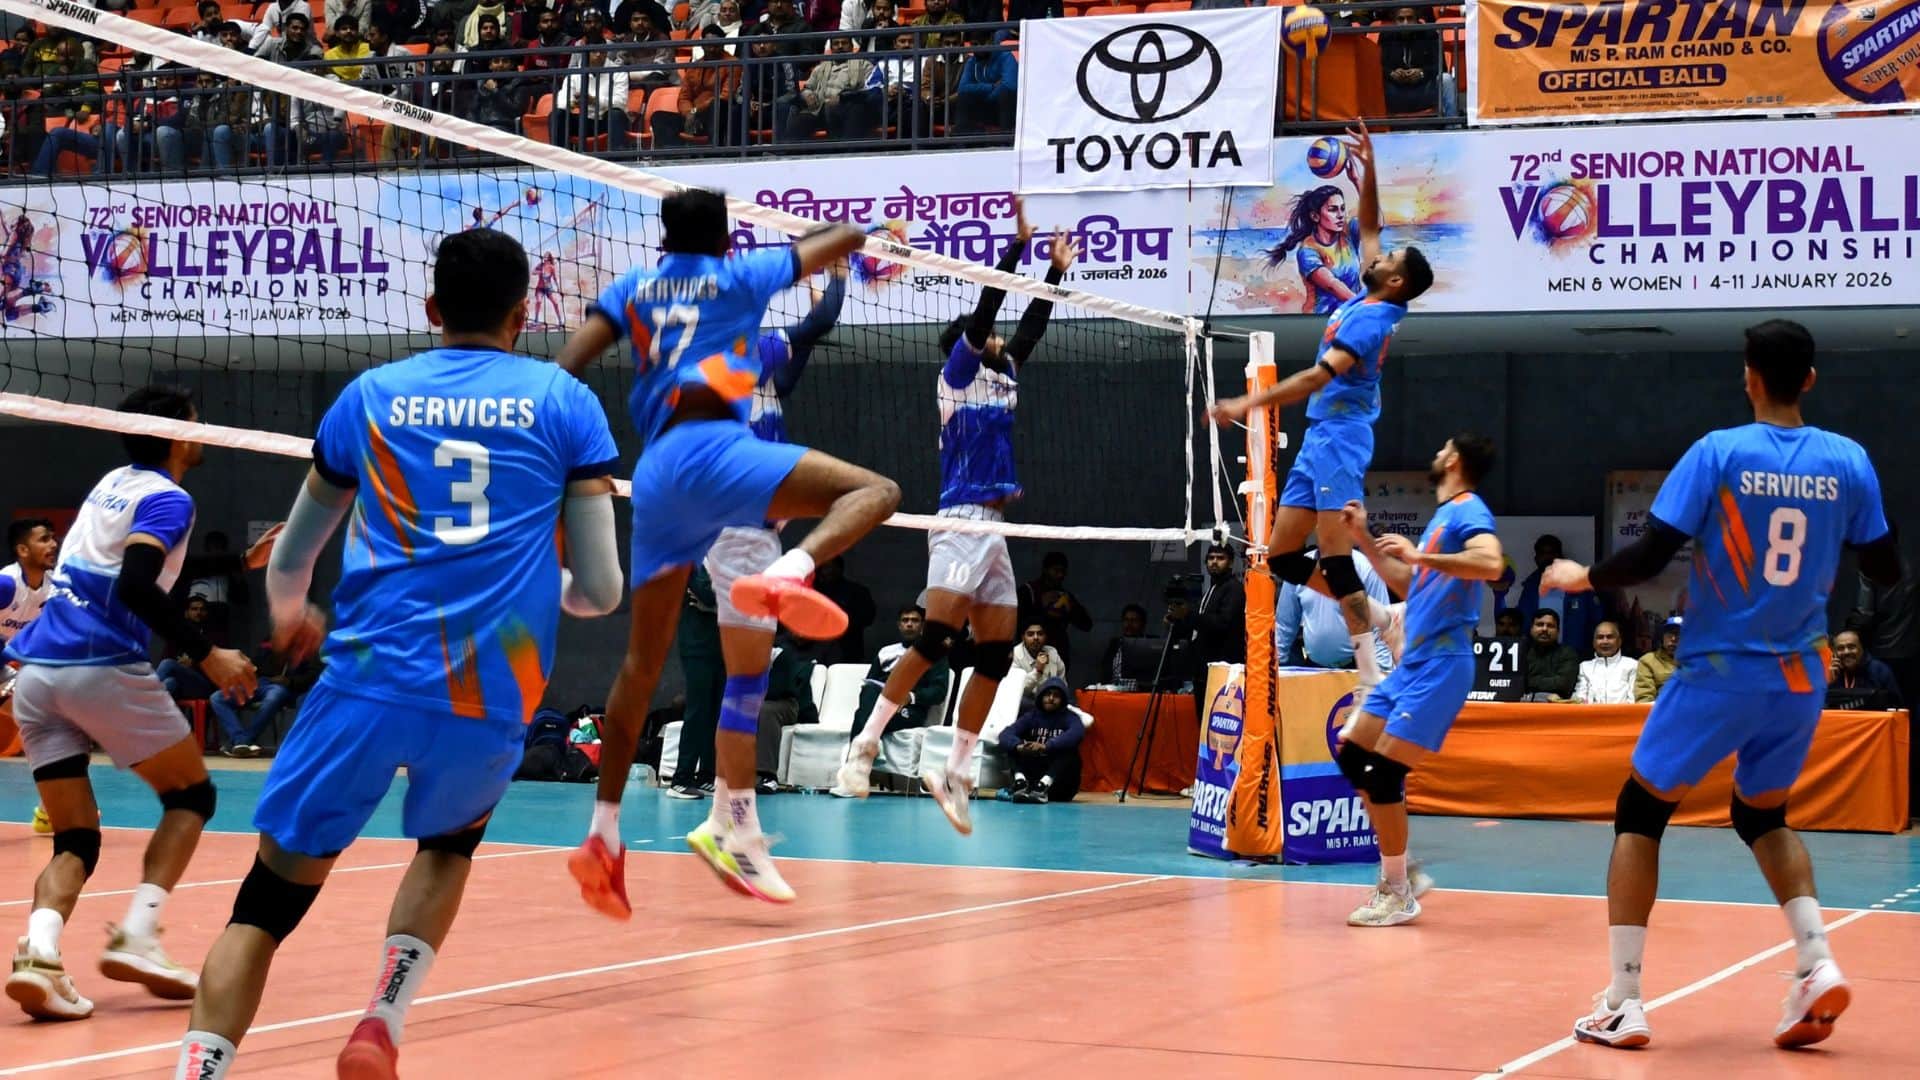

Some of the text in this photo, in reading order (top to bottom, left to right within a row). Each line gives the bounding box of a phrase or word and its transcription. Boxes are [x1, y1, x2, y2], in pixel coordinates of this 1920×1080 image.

[46, 0, 99, 25] SPARTAN
[1494, 0, 1806, 49] SPARTAN
[1570, 39, 1791, 63] M/S P. RAM CHAND & CO.
[1841, 6, 1920, 70] SPARTAN
[1897, 42, 1920, 66] VOL
[1544, 67, 1720, 90] OFFICIAL BALL
[393, 101, 433, 123] SPARTAN
[1047, 130, 1243, 174] TOYOTA
[1510, 145, 1865, 181] 72nd SENIOR NATIONAL
[89, 202, 337, 229] 72nd SENIOR NATIONAL
[1138, 267, 1168, 280] 2026
[1548, 276, 1585, 292] MEN
[1611, 274, 1682, 291] WOMEN
[1710, 273, 1744, 289] 4-11
[1751, 272, 1838, 289] JANUARY
[1845, 271, 1893, 288] 2026
[140, 278, 390, 301] CHAMPIONSHIP
[110, 310, 137, 323] MEN
[154, 309, 205, 322] WOMEN
[224, 308, 249, 321] 4-11
[252, 308, 313, 321] JANUARY
[649, 302, 700, 370] 17
[389, 396, 535, 429] SERVICES
[434, 439, 490, 545] 3
[1739, 470, 1839, 501] SERVICES
[1763, 506, 1807, 587] 8
[1488, 641, 1519, 672] 21
[1489, 678, 1511, 688] GUEST
[1211, 715, 1240, 732] SPARTAN
[1326, 837, 1342, 849] M/S
[1353, 836, 1371, 846] RAM
[381, 958, 413, 1004] UNDER
